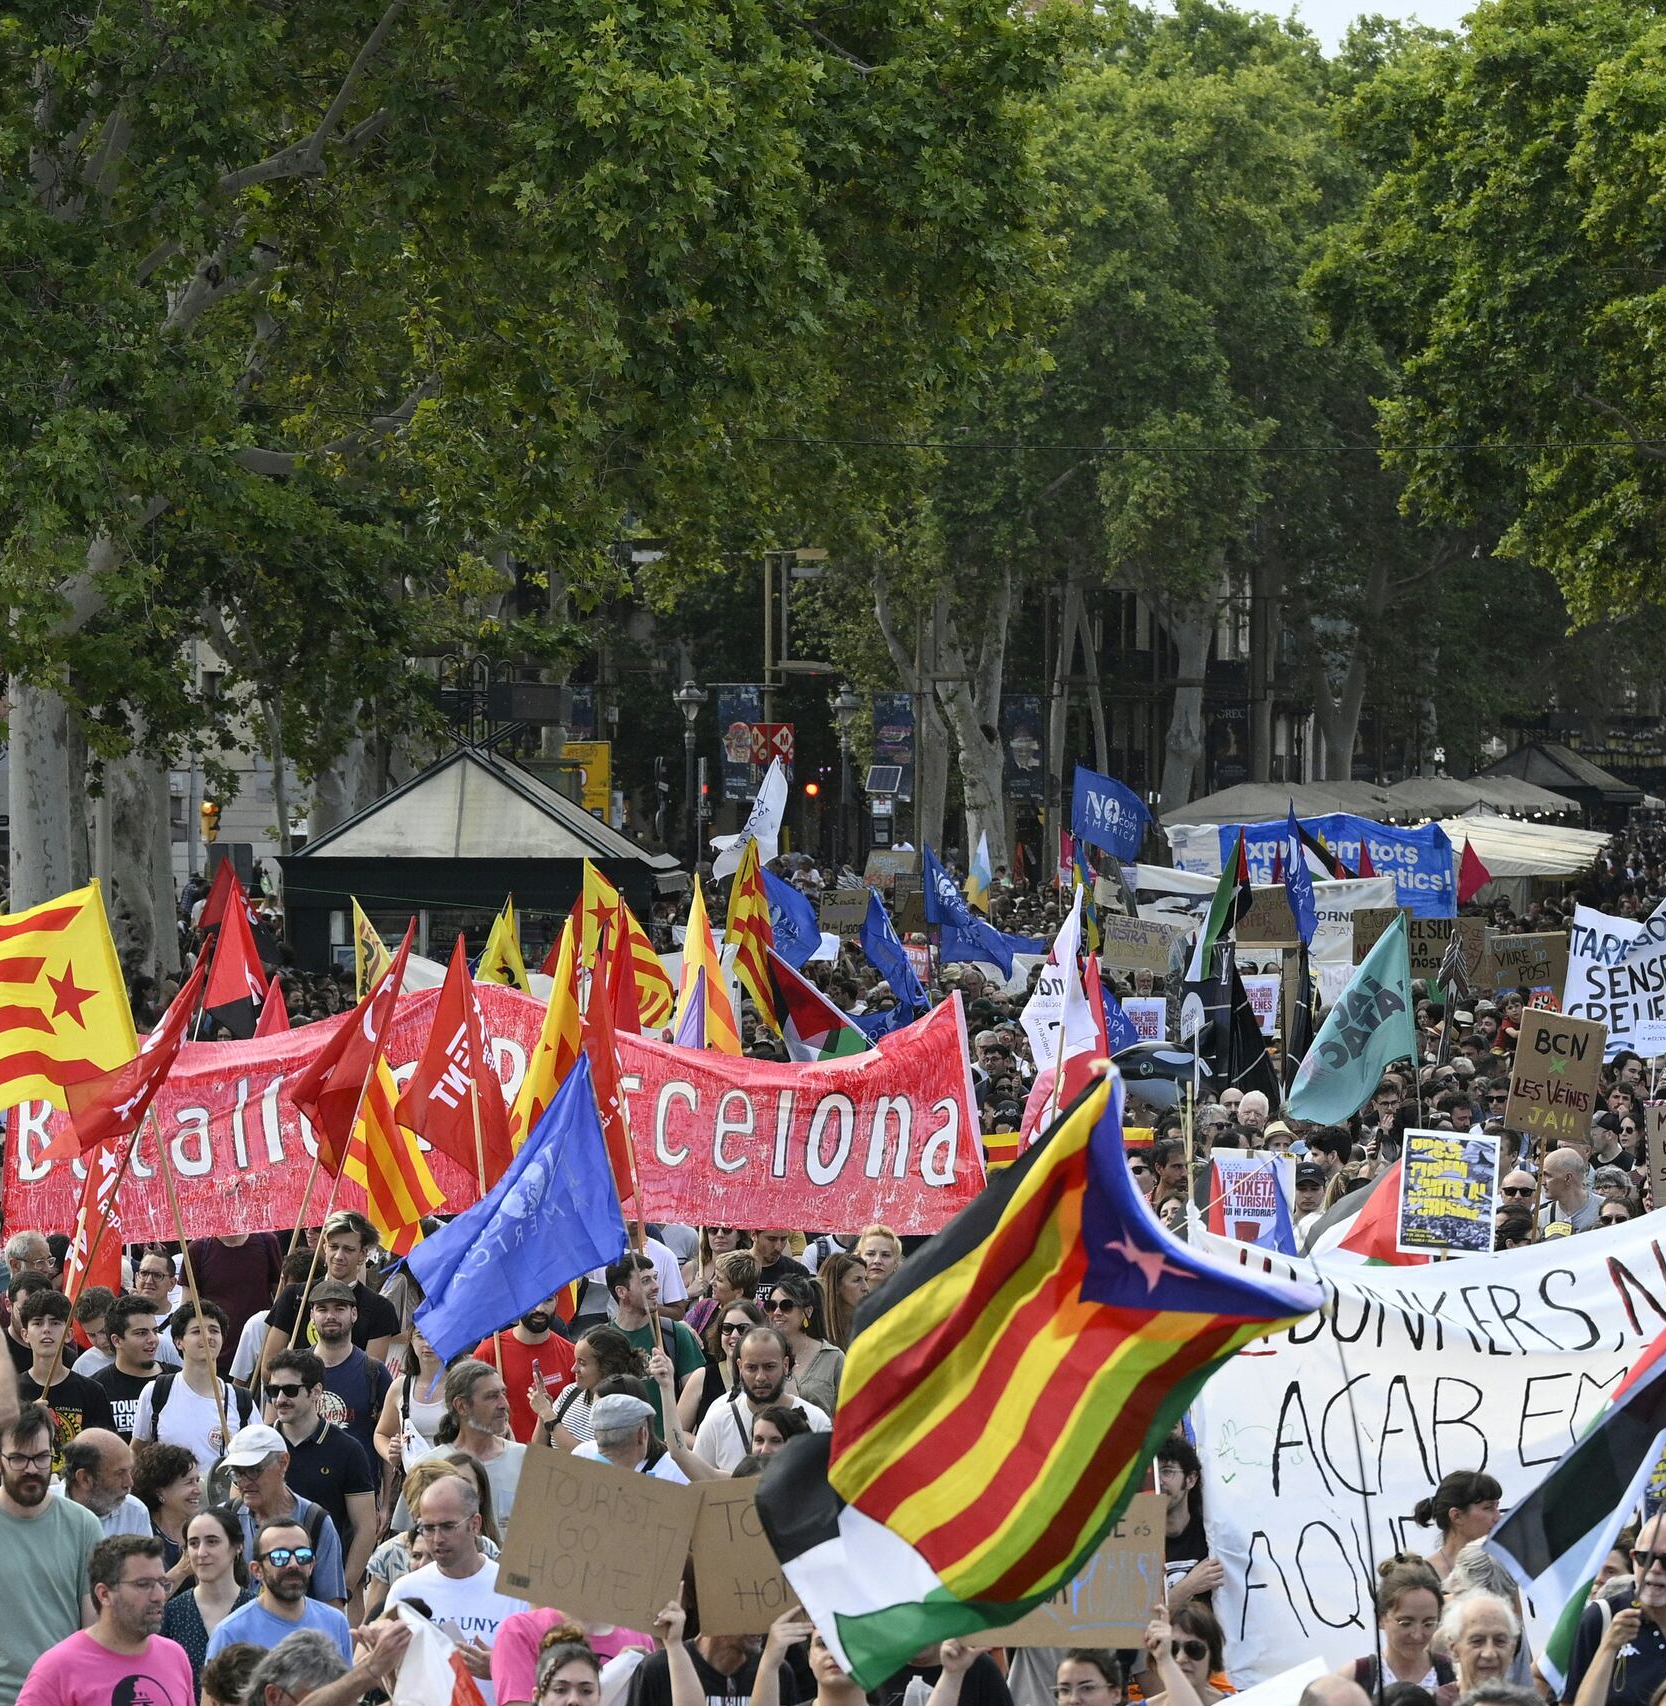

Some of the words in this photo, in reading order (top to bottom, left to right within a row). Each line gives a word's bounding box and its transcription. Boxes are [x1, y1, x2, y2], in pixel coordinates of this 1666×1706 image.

[1368, 838, 1419, 865] tots
[1411, 942, 1428, 956] LA
[1534, 1028, 1589, 1061] BCN
[1513, 1076, 1541, 1102] LES
[1236, 1196, 1277, 1208] TURISME
[543, 1462, 659, 1528] TOURIST
[557, 1516, 601, 1552] GO
